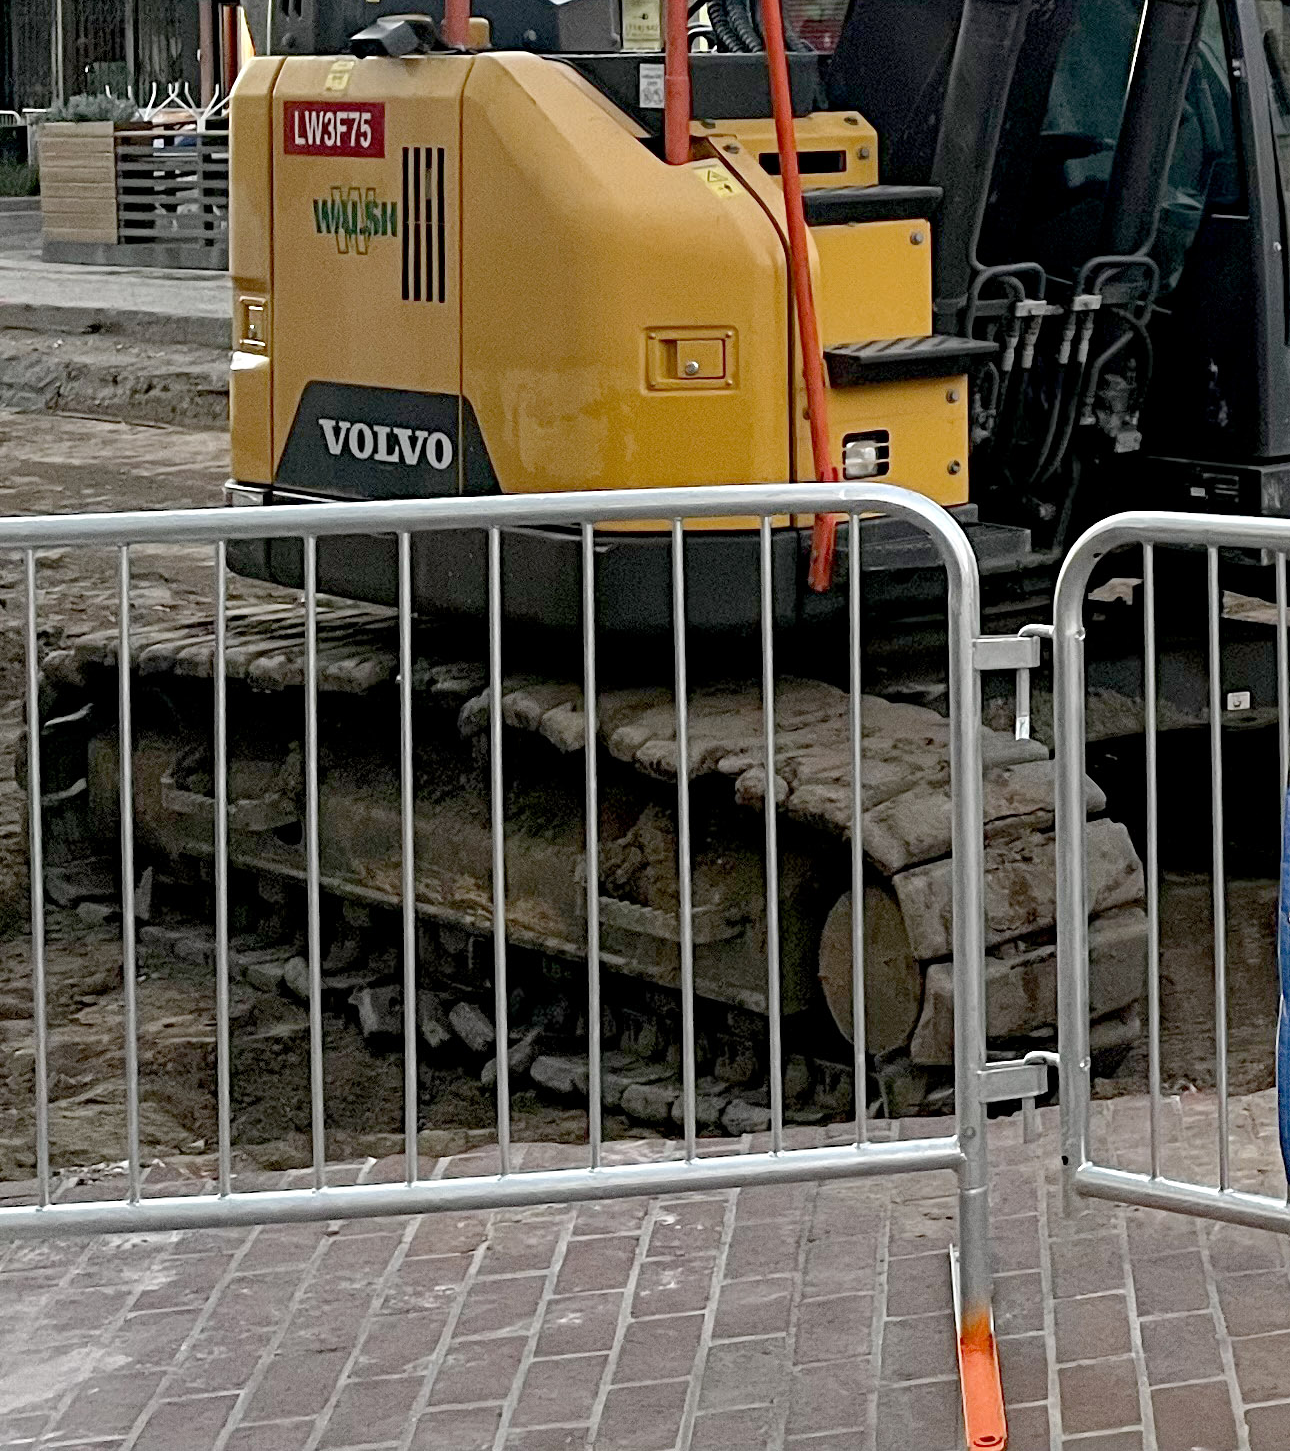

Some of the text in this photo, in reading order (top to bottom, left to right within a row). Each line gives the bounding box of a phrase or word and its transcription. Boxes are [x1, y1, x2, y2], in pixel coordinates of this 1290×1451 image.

[294, 111, 372, 148] LW3F75
[313, 198, 398, 237] WALSH
[318, 418, 453, 470] VOLVO
